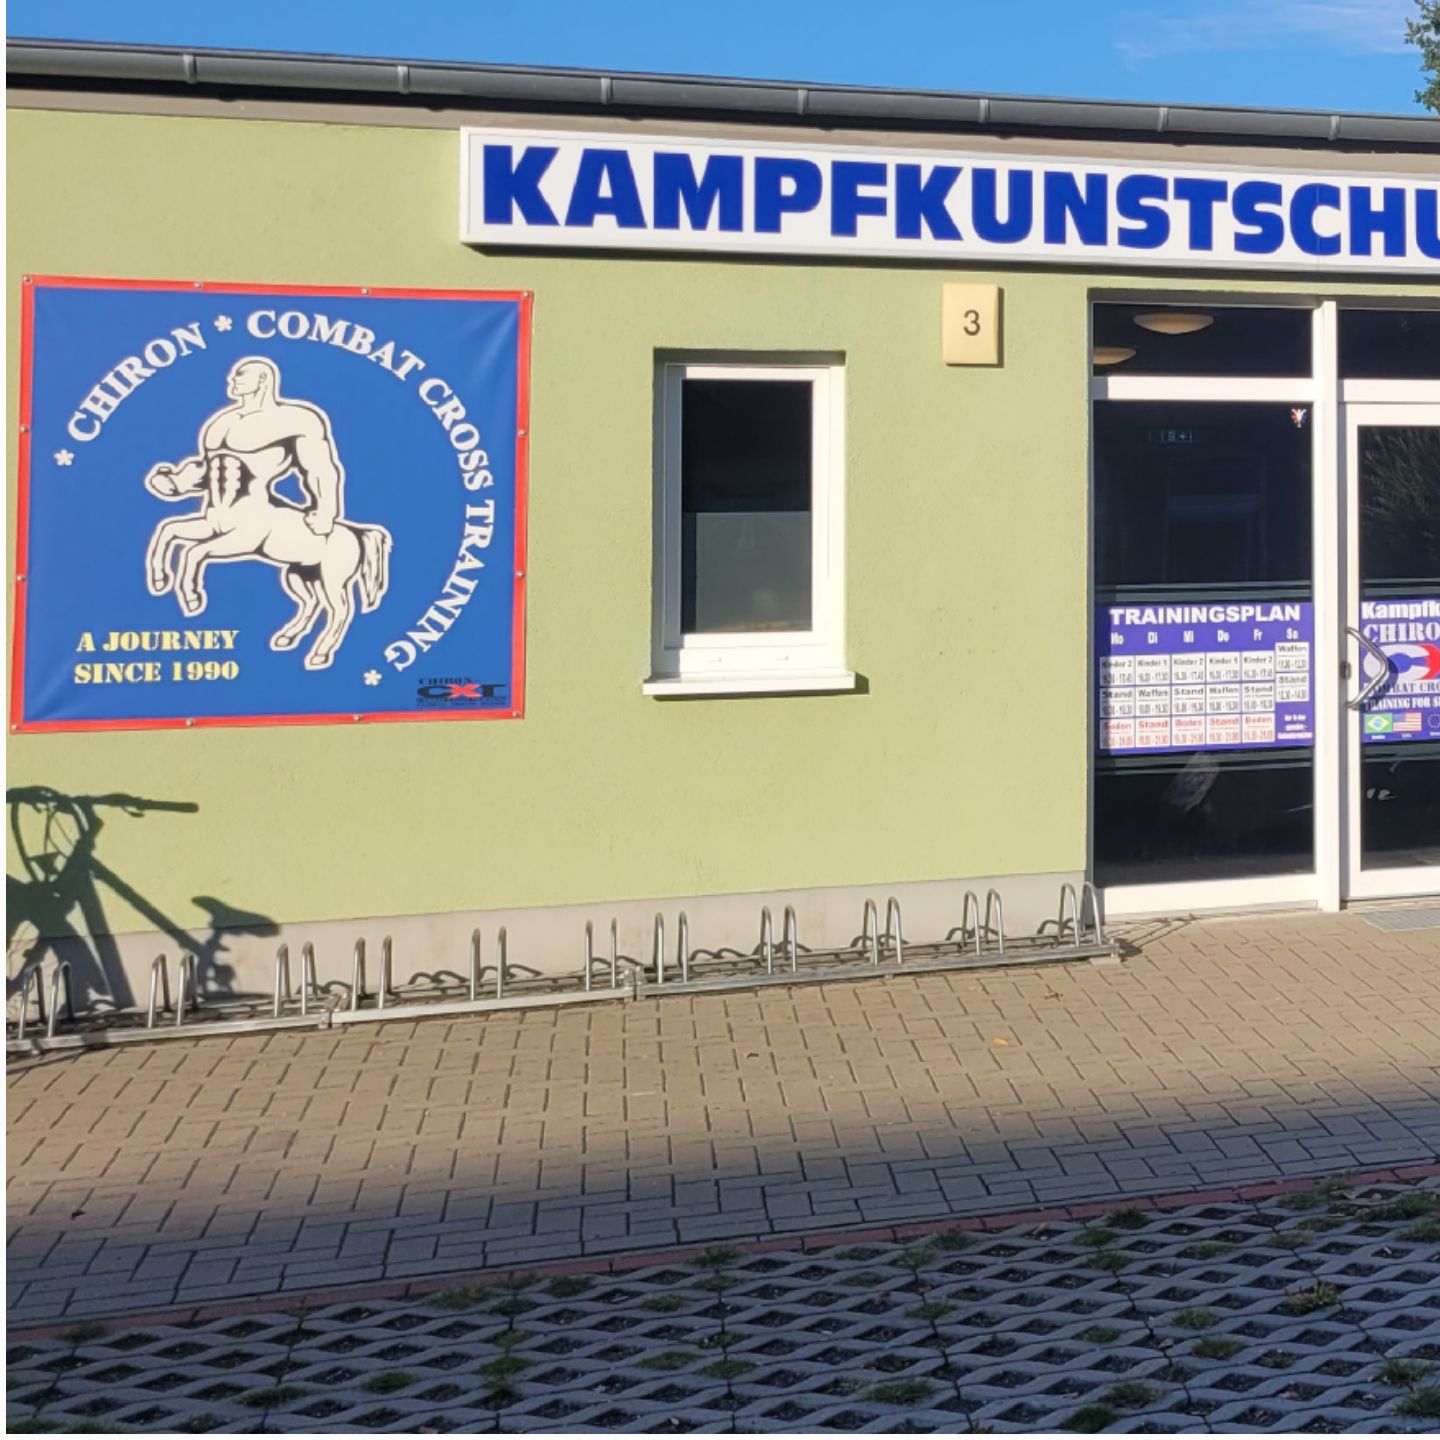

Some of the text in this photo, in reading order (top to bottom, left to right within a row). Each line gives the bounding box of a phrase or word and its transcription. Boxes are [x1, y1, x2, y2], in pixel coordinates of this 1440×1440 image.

[962, 309, 982, 337] 3
[67, 310, 496, 673] CHIRON COMBAT CROSS TRAINING
[1109, 605, 1301, 625] TRAININGSPLAN
[76, 630, 240, 654] A JOURNEY
[1147, 631, 1158, 644] Di
[1217, 628, 1231, 642] Do
[1253, 628, 1263, 641] Fr
[1286, 627, 1299, 640] Sa
[74, 660, 240, 684] SINCE 1990
[416, 683, 506, 699] CXT
[1174, 687, 1204, 696] Stand
[1411, 695, 1431, 709] FOR
